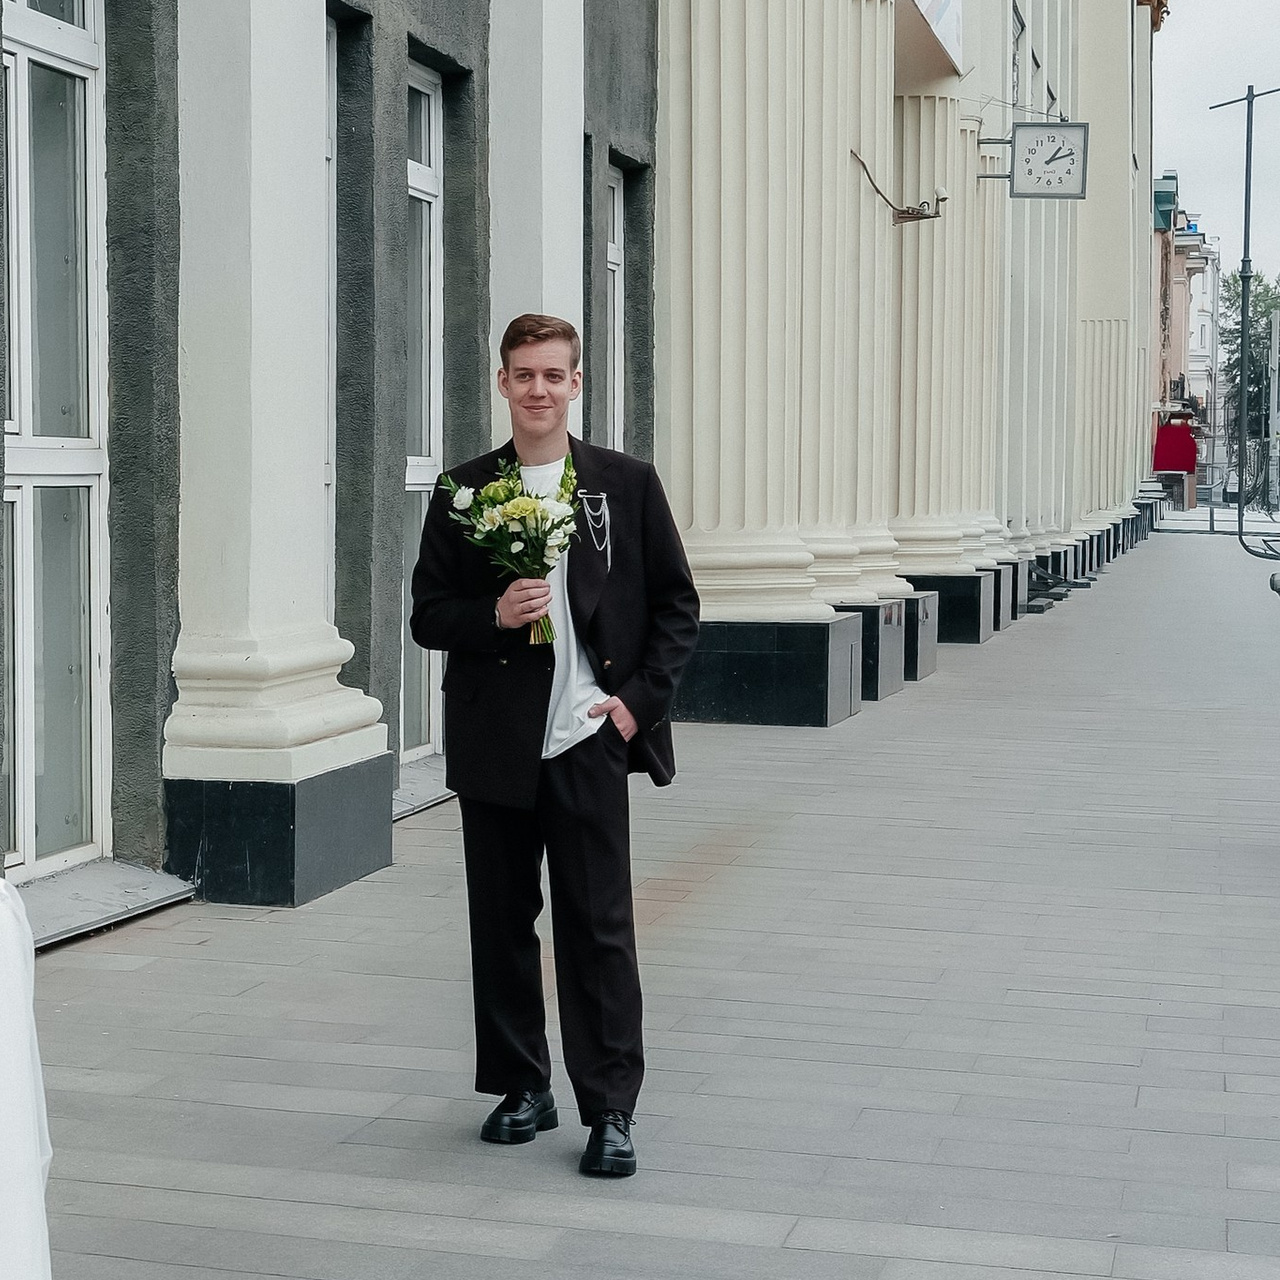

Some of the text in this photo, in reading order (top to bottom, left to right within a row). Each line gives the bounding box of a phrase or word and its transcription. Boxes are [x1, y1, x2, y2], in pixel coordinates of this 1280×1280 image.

[1047, 135, 1056, 143] 12
[1024, 157, 1030, 165] 9
[1027, 168, 1033, 176] 8
